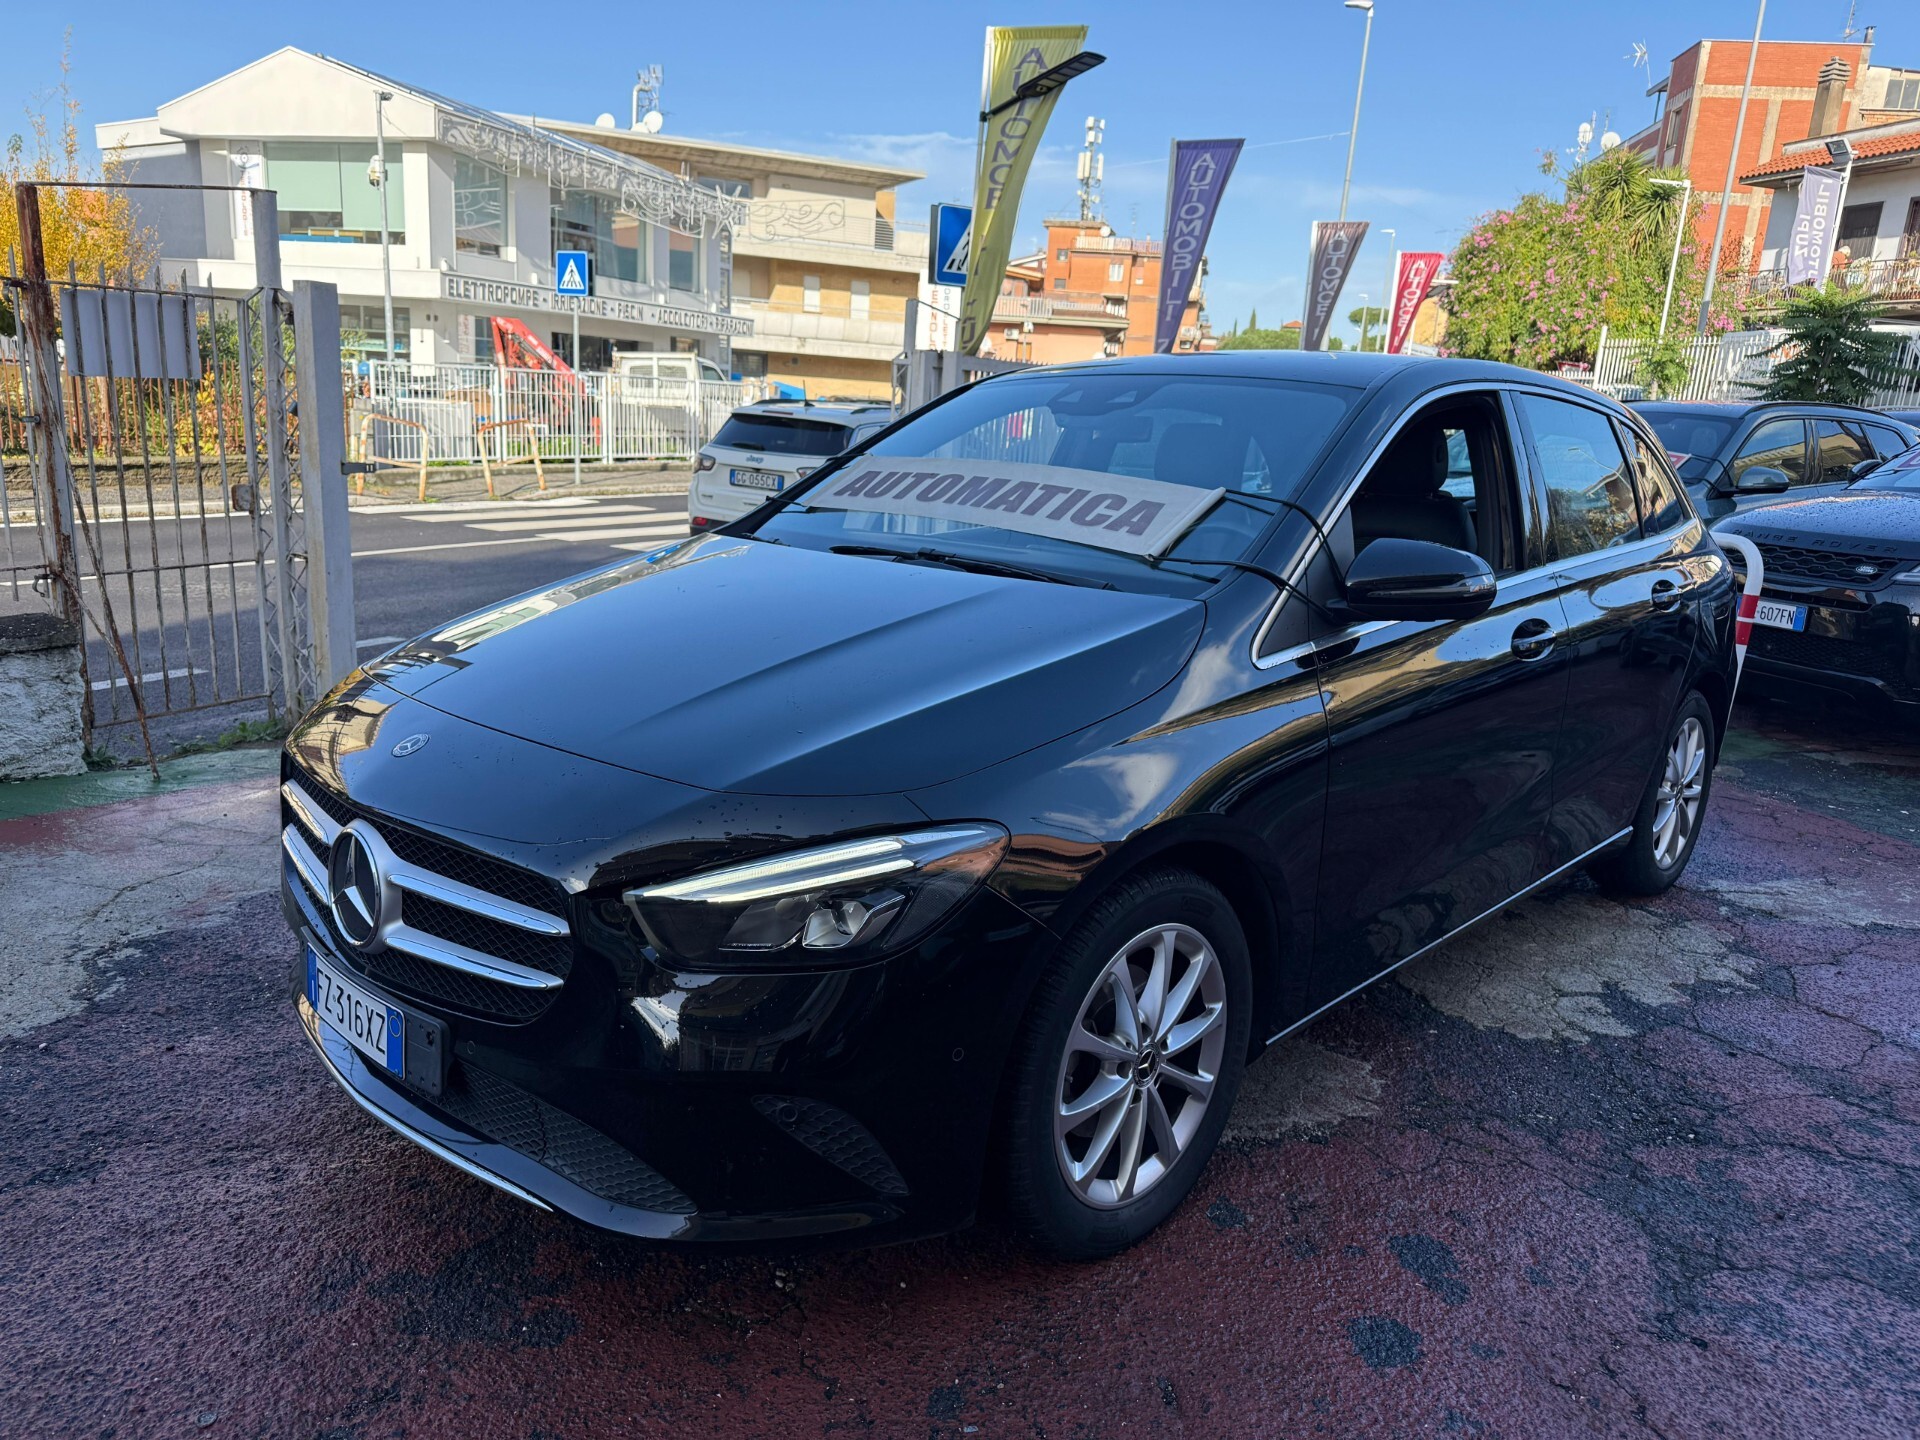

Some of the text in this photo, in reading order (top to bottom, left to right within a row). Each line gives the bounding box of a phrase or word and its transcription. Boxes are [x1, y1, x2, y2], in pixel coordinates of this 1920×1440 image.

[1166, 153, 1217, 321] AUTOMOBILI
[447, 277, 539, 308] ELETTROPOMPE
[833, 470, 1165, 536] AUTOMATICA
[1811, 539, 1898, 552] ROVER
